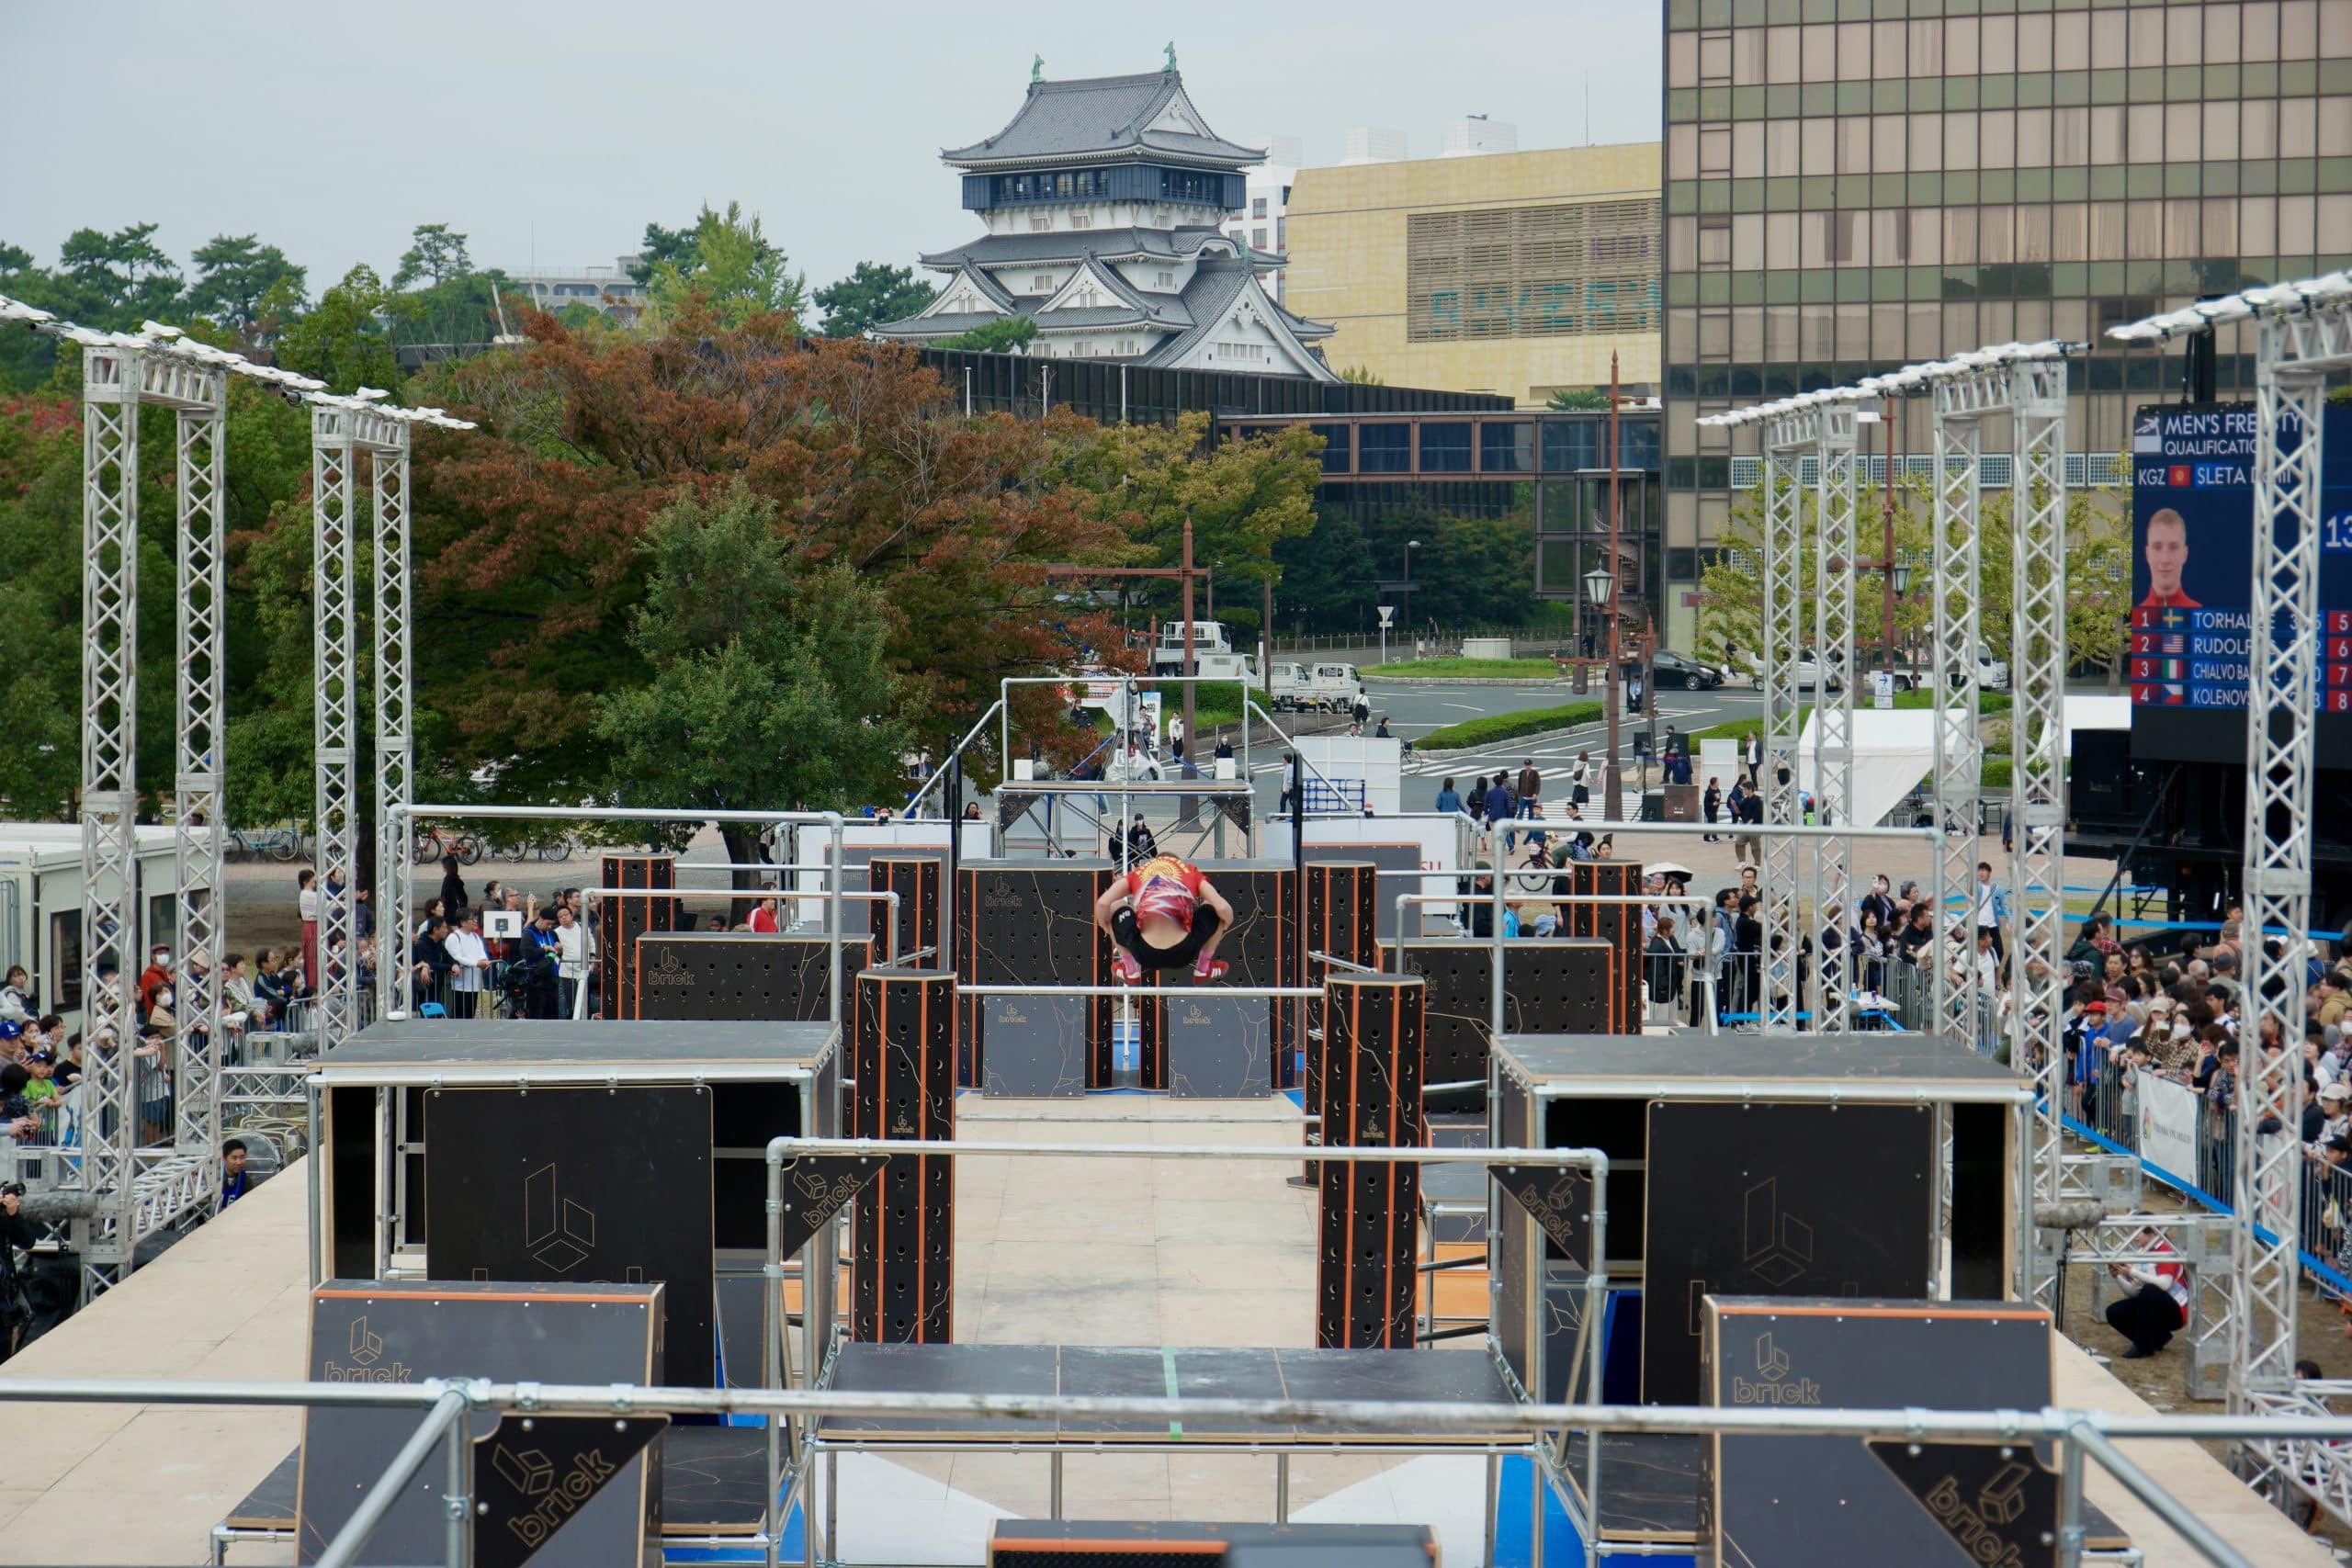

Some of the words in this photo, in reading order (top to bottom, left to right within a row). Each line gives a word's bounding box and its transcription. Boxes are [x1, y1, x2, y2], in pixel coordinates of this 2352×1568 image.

[2165, 413, 2220, 434] MEN'S
[2138, 468, 2166, 486] KGZ
[2197, 467, 2247, 485] SLETA
[2142, 612, 2150, 627] 1
[2338, 615, 2348, 630] 5
[2141, 637, 2150, 652] 2
[2338, 641, 2348, 658] 6
[2141, 661, 2150, 677] 3
[2194, 663, 2236, 681] CHIALVO
[2338, 667, 2348, 683] 7
[2141, 687, 2150, 703] 4
[2338, 694, 2348, 710] 8
[648, 970, 695, 986] brick
[802, 1173, 862, 1229] brick
[1519, 1183, 1574, 1244] brick
[324, 1361, 412, 1383] brick
[1734, 1376, 1821, 1404] brick
[506, 1448, 616, 1548] brick
